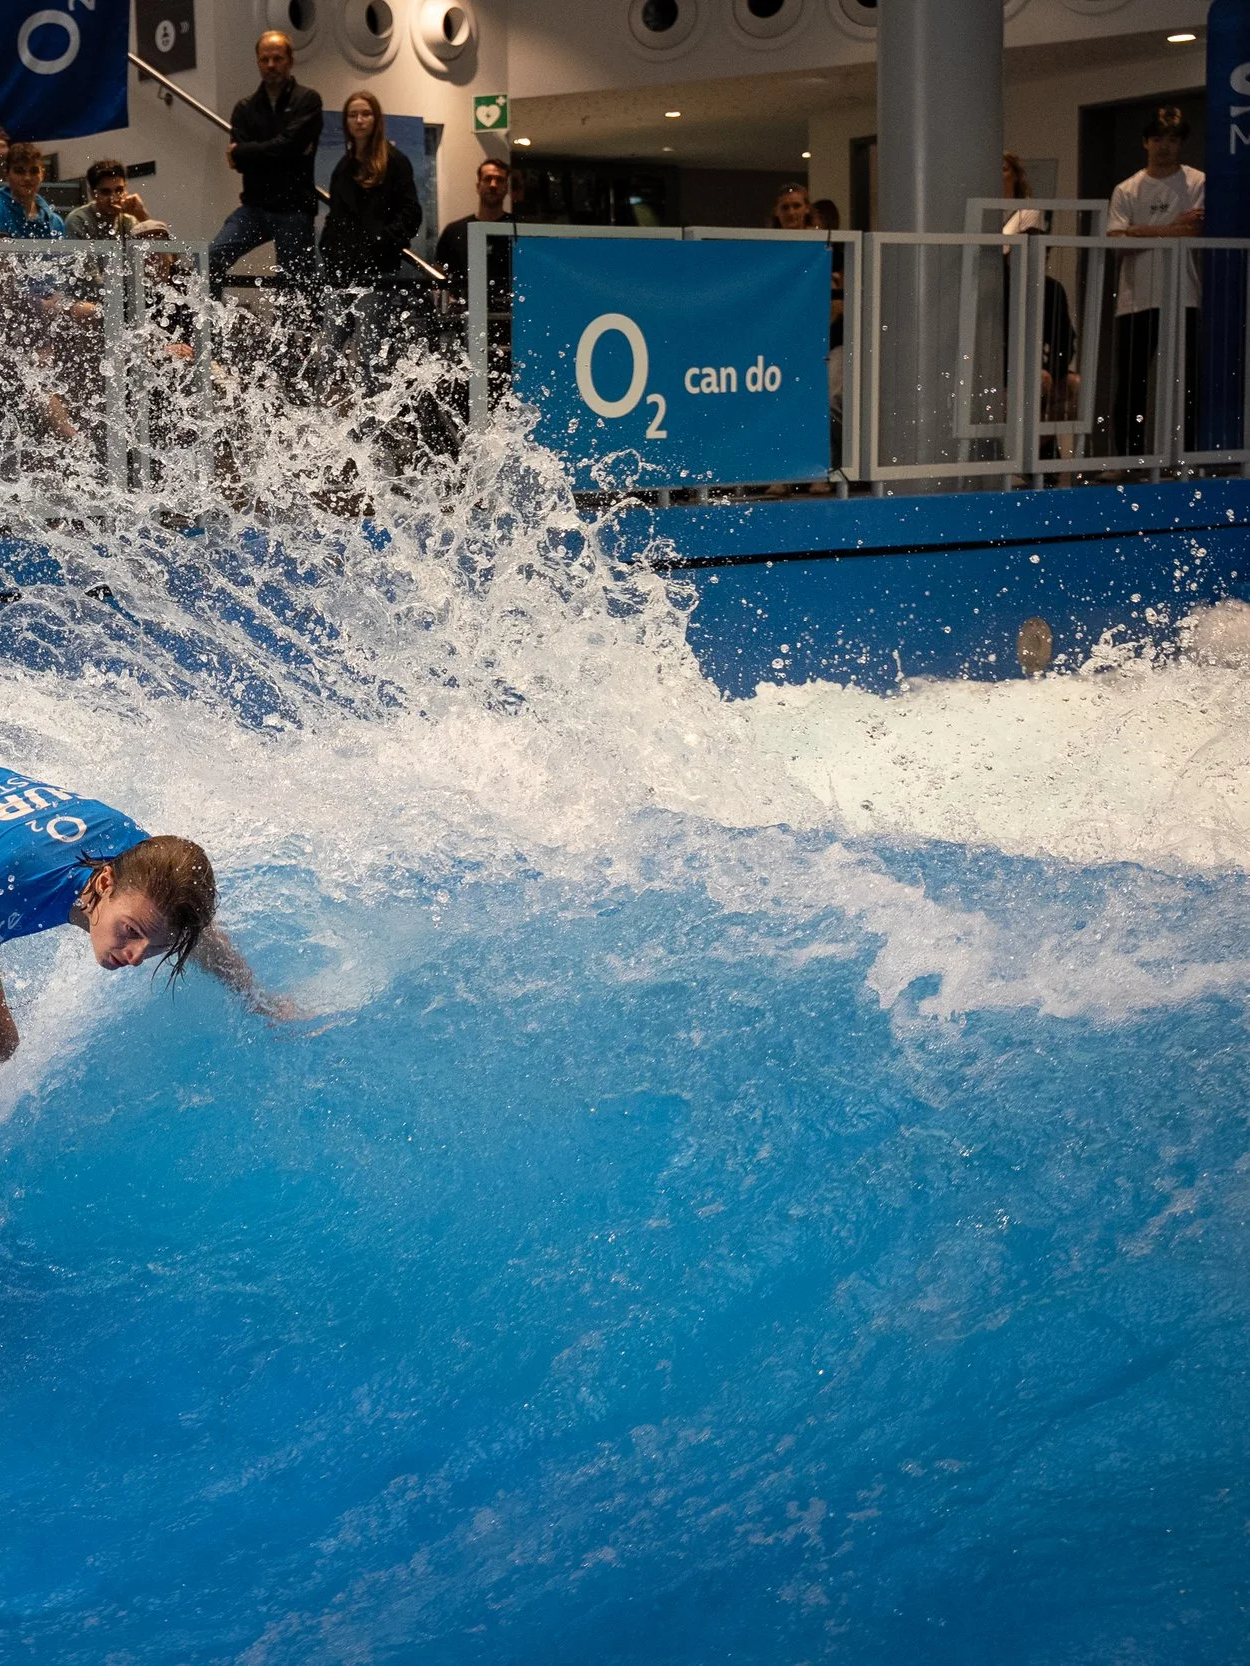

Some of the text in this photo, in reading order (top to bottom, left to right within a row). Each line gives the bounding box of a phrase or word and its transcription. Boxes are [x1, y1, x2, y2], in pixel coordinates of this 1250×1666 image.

[575, 312, 782, 440] O2 can do
[24, 815, 88, 844] O2
